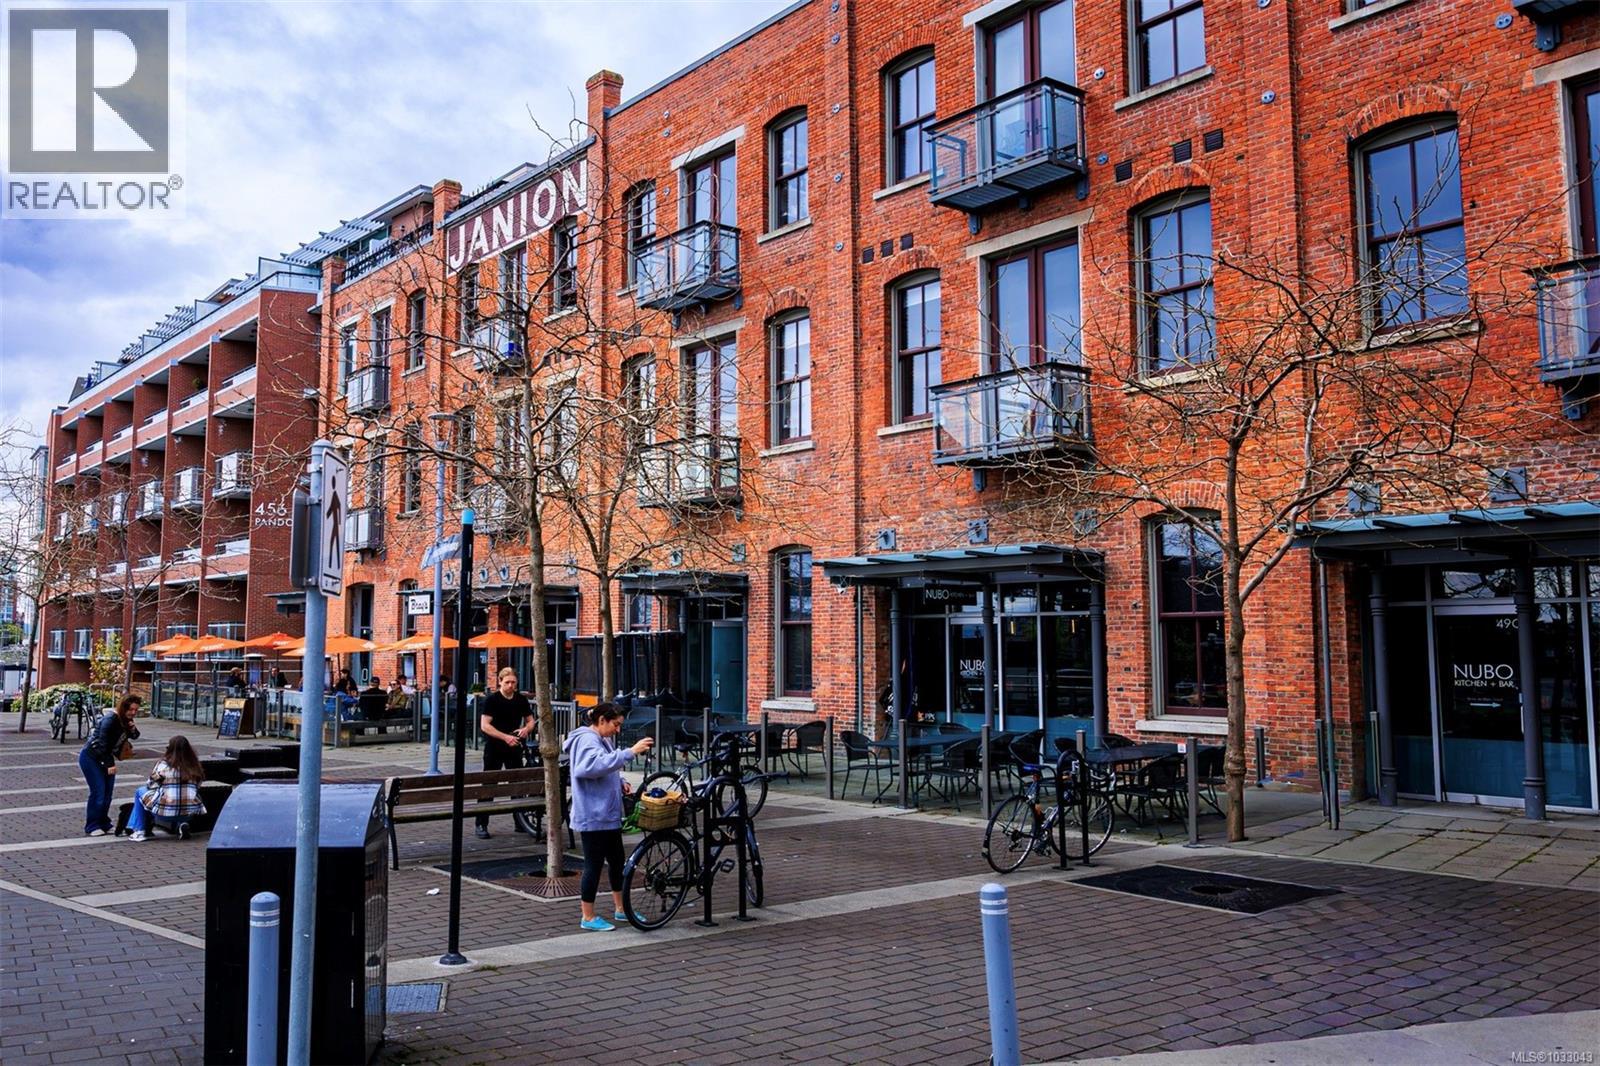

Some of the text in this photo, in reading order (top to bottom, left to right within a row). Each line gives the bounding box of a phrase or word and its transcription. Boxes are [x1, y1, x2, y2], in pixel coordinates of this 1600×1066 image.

[449, 159, 588, 269] JANION
[255, 502, 287, 516] 456
[925, 589, 950, 600] NUBO
[1453, 664, 1514, 680] NUBO
